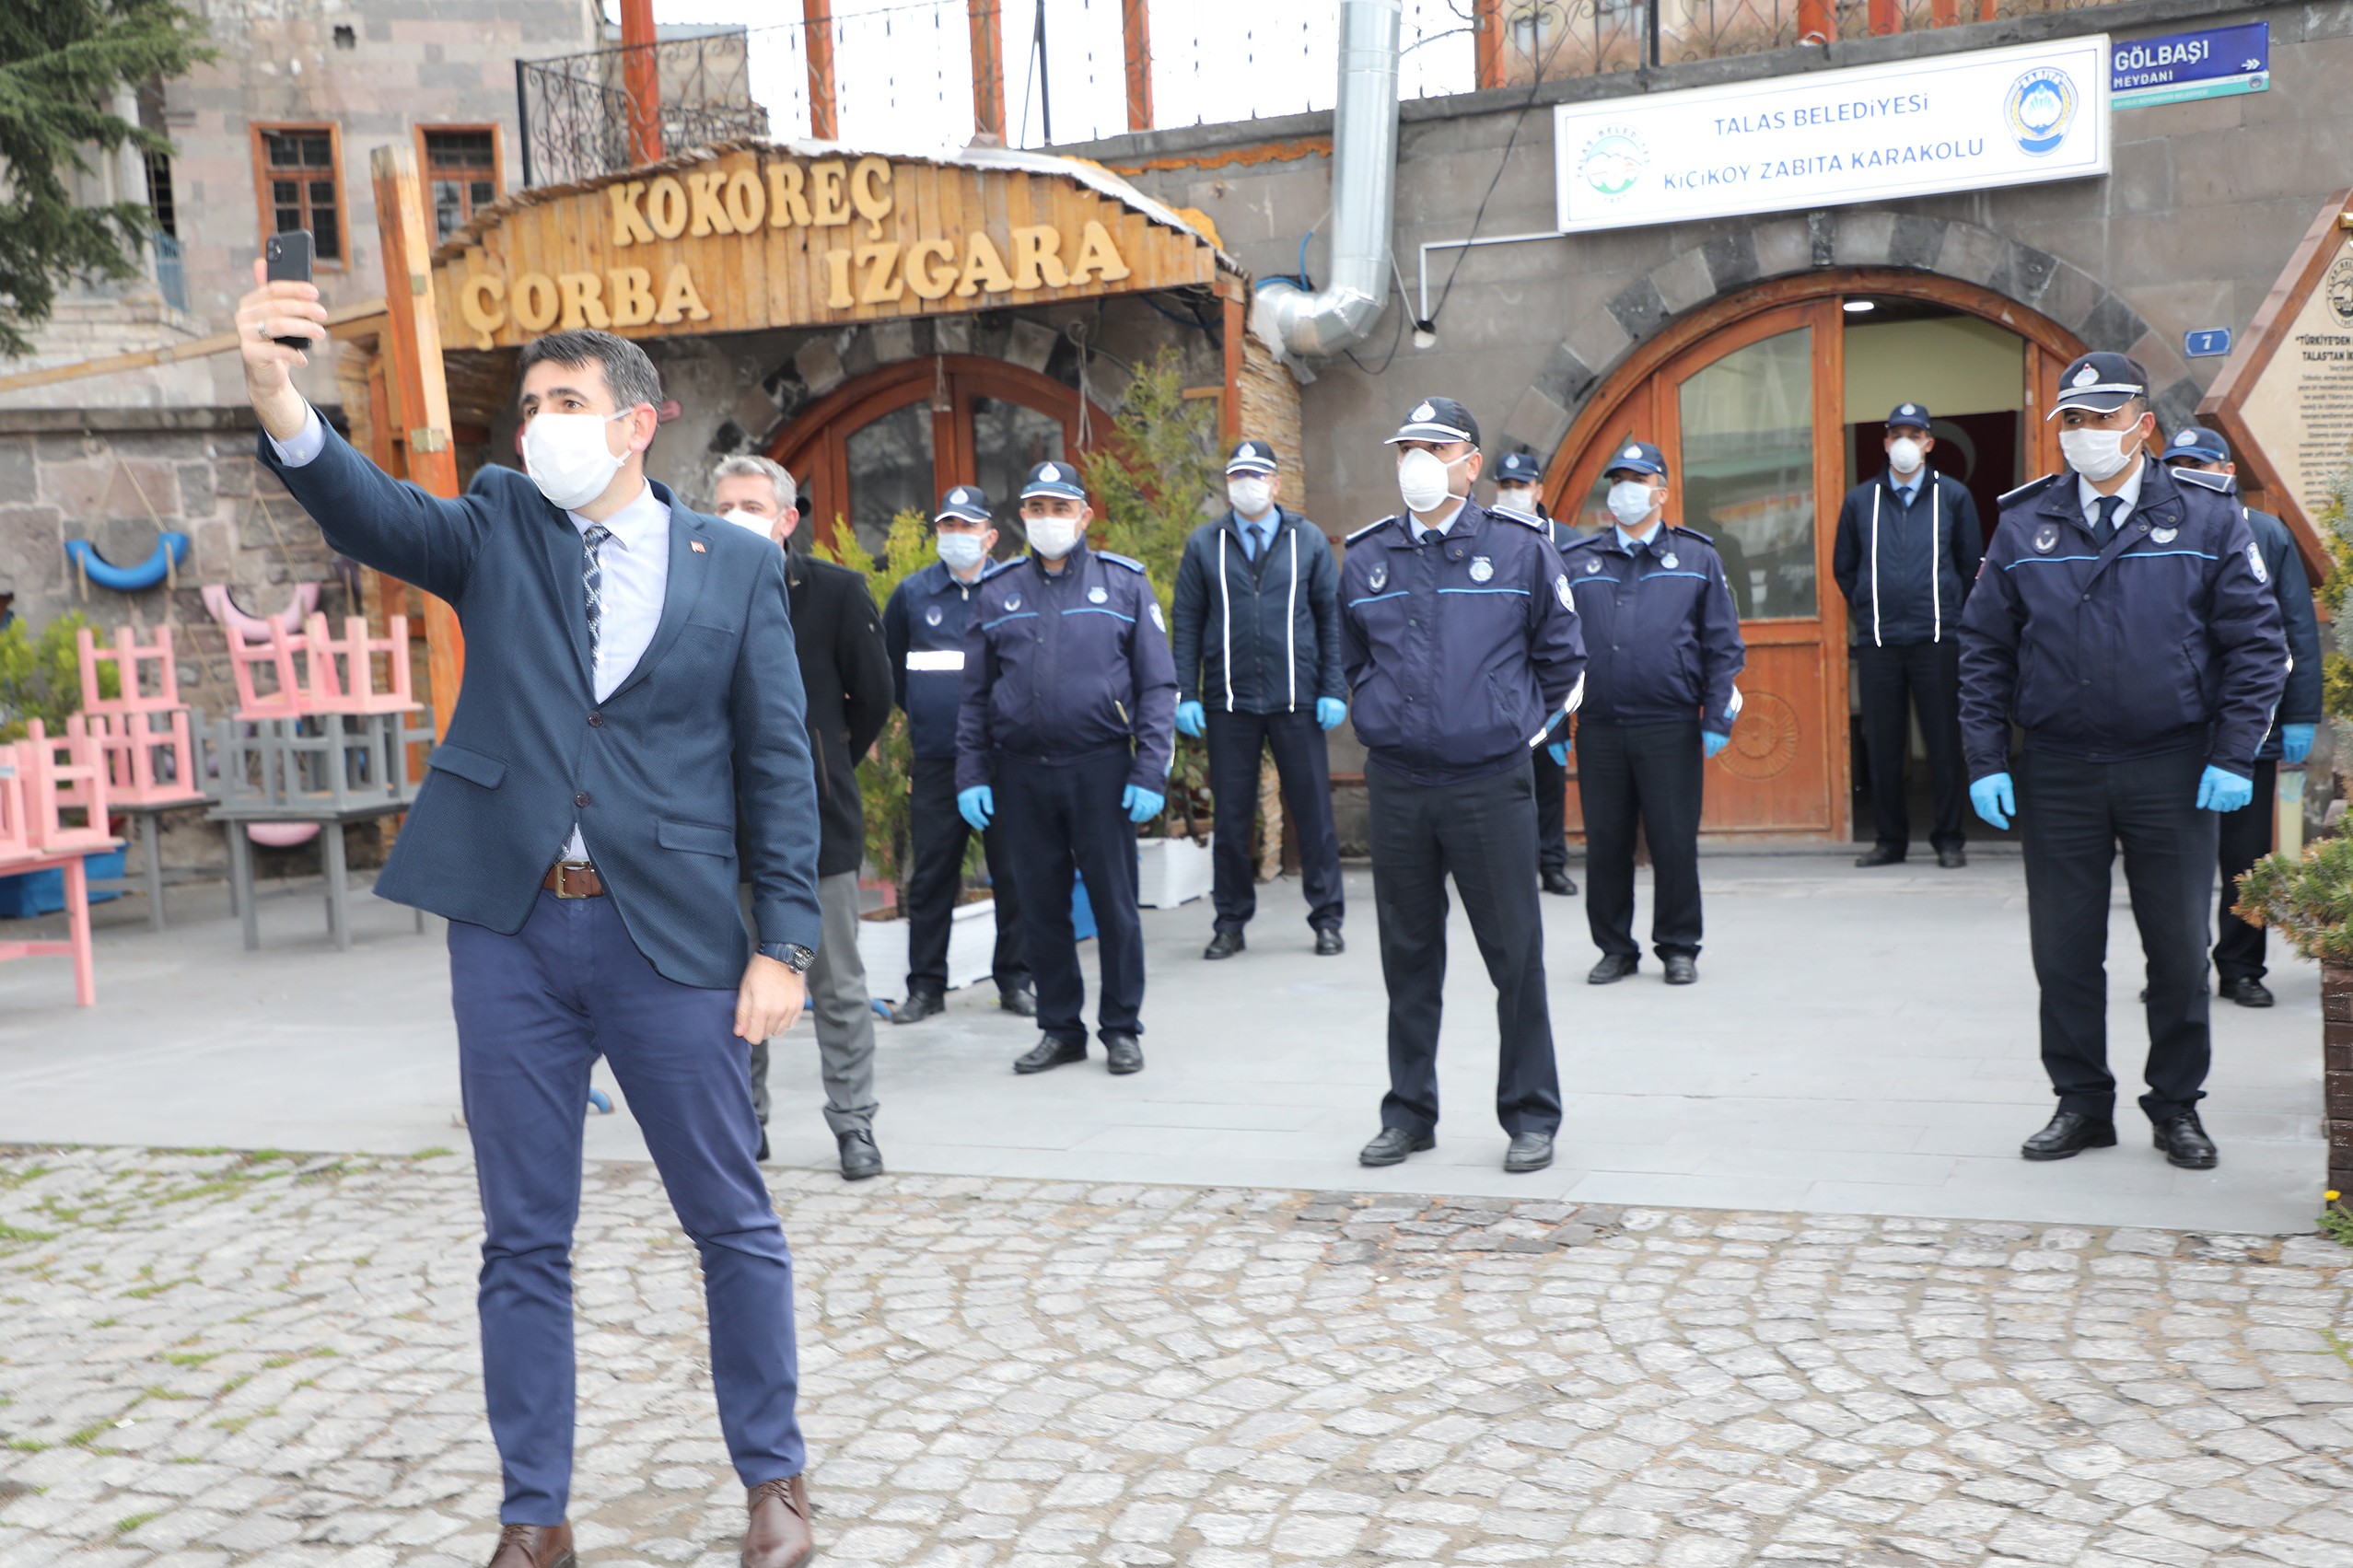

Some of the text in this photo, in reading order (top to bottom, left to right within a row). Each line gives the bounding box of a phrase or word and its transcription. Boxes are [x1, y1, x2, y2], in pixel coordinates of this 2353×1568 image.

[2114, 40, 2208, 71] GÖLBAŞI
[2114, 70, 2173, 88] MEYDANI
[1715, 111, 1786, 135] TALAS
[1760, 155, 1842, 180] ZABITA
[1852, 138, 1983, 169] KARAKOLU
[608, 157, 893, 246] KOKOREÇ
[461, 220, 1131, 351] ÇORBA IZGARA
[2202, 333, 2213, 350] 7
